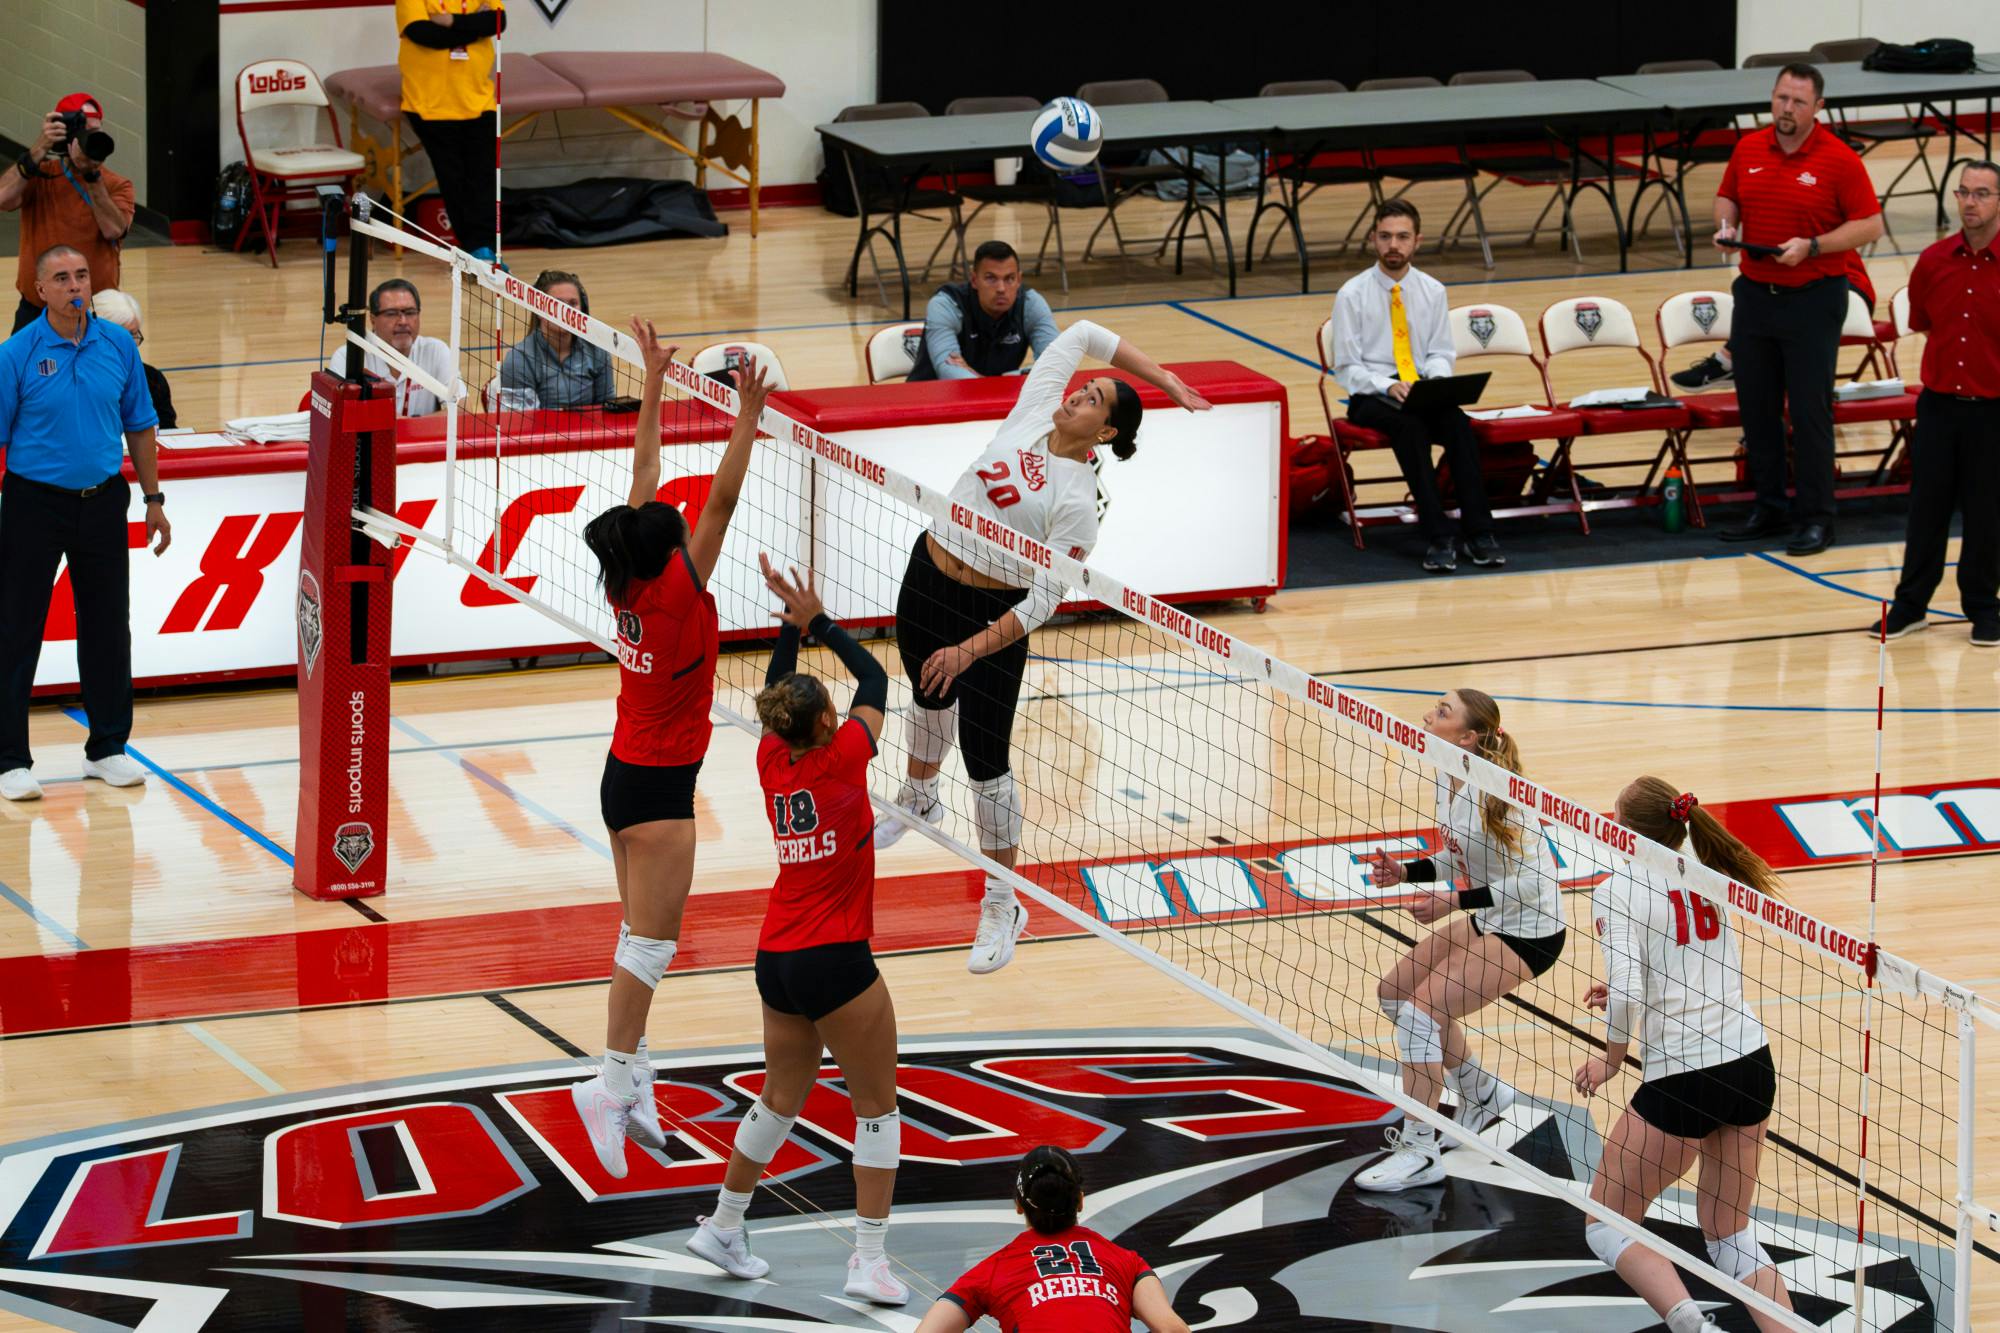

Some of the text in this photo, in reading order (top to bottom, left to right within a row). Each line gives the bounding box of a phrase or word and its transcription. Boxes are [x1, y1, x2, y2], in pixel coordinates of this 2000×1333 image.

[505, 277, 589, 334] NEW MEXICO LOBOS
[702, 378, 731, 408] LOBOS
[792, 423, 886, 486] NEW MEXICO LOBOS
[1017, 449, 1048, 492] Lobos
[976, 461, 1022, 510] 20
[951, 502, 973, 531] NEW
[976, 514, 1015, 551] MEXICO
[1019, 535, 1052, 569] LOBOS
[1122, 586, 1231, 658] NEW MEXICO LOBOS
[1307, 678, 1426, 754] NEW MEXICO LOBOS
[347, 691, 366, 814] sports imports
[774, 788, 819, 836] 18
[1508, 776, 1637, 856] NEW MEXICO LOBOS
[1667, 889, 1721, 947] 16
[1727, 881, 1867, 966] NEW MEXICO LOBOS
[865, 1121, 880, 1133] 18
[1030, 1240, 1103, 1279] 21
[1026, 1276, 1119, 1308] REBELS
